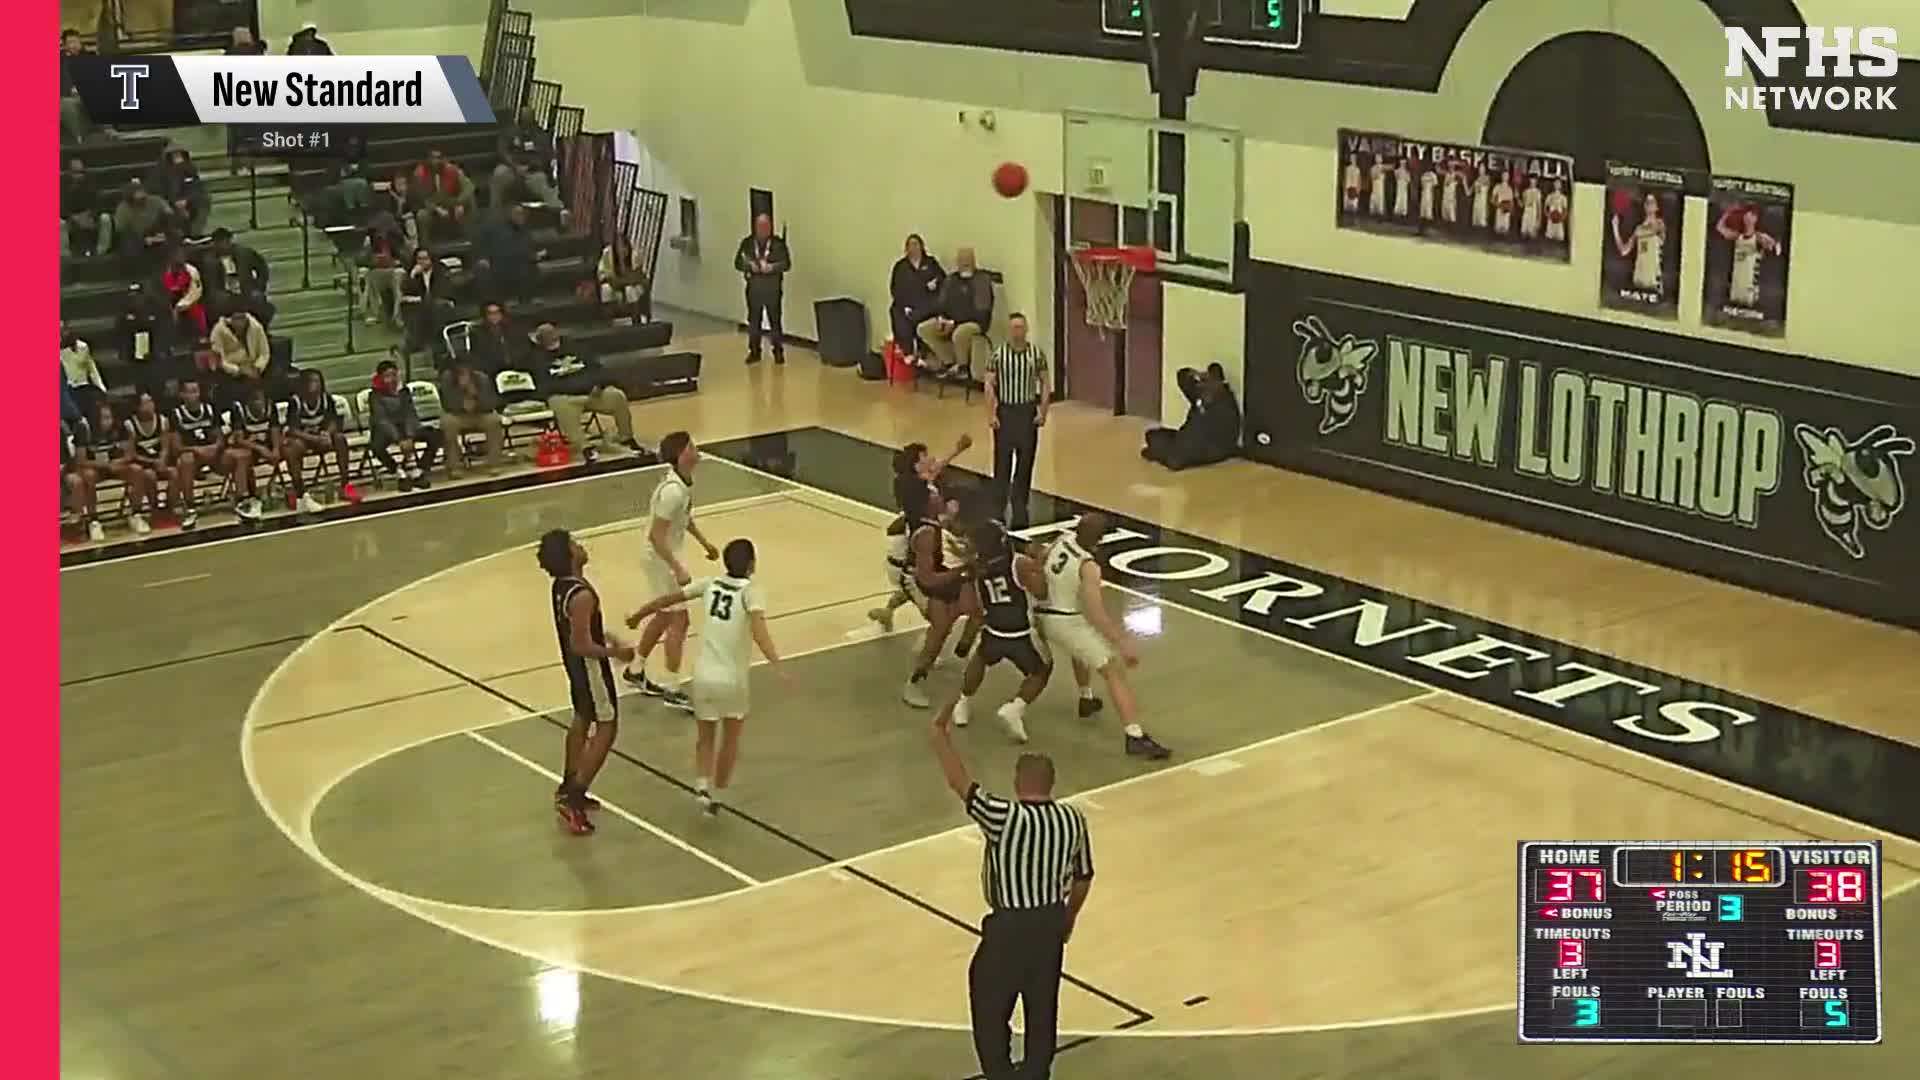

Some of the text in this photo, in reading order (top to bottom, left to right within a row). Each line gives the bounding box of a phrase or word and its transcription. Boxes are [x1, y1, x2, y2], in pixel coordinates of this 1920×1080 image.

[1384, 337, 1781, 526] NEW LOTHROP
[1051, 552, 1069, 574] 3
[984, 576, 1011, 603] 12
[710, 590, 733, 620] 13
[1008, 515, 1757, 744] HORNETS
